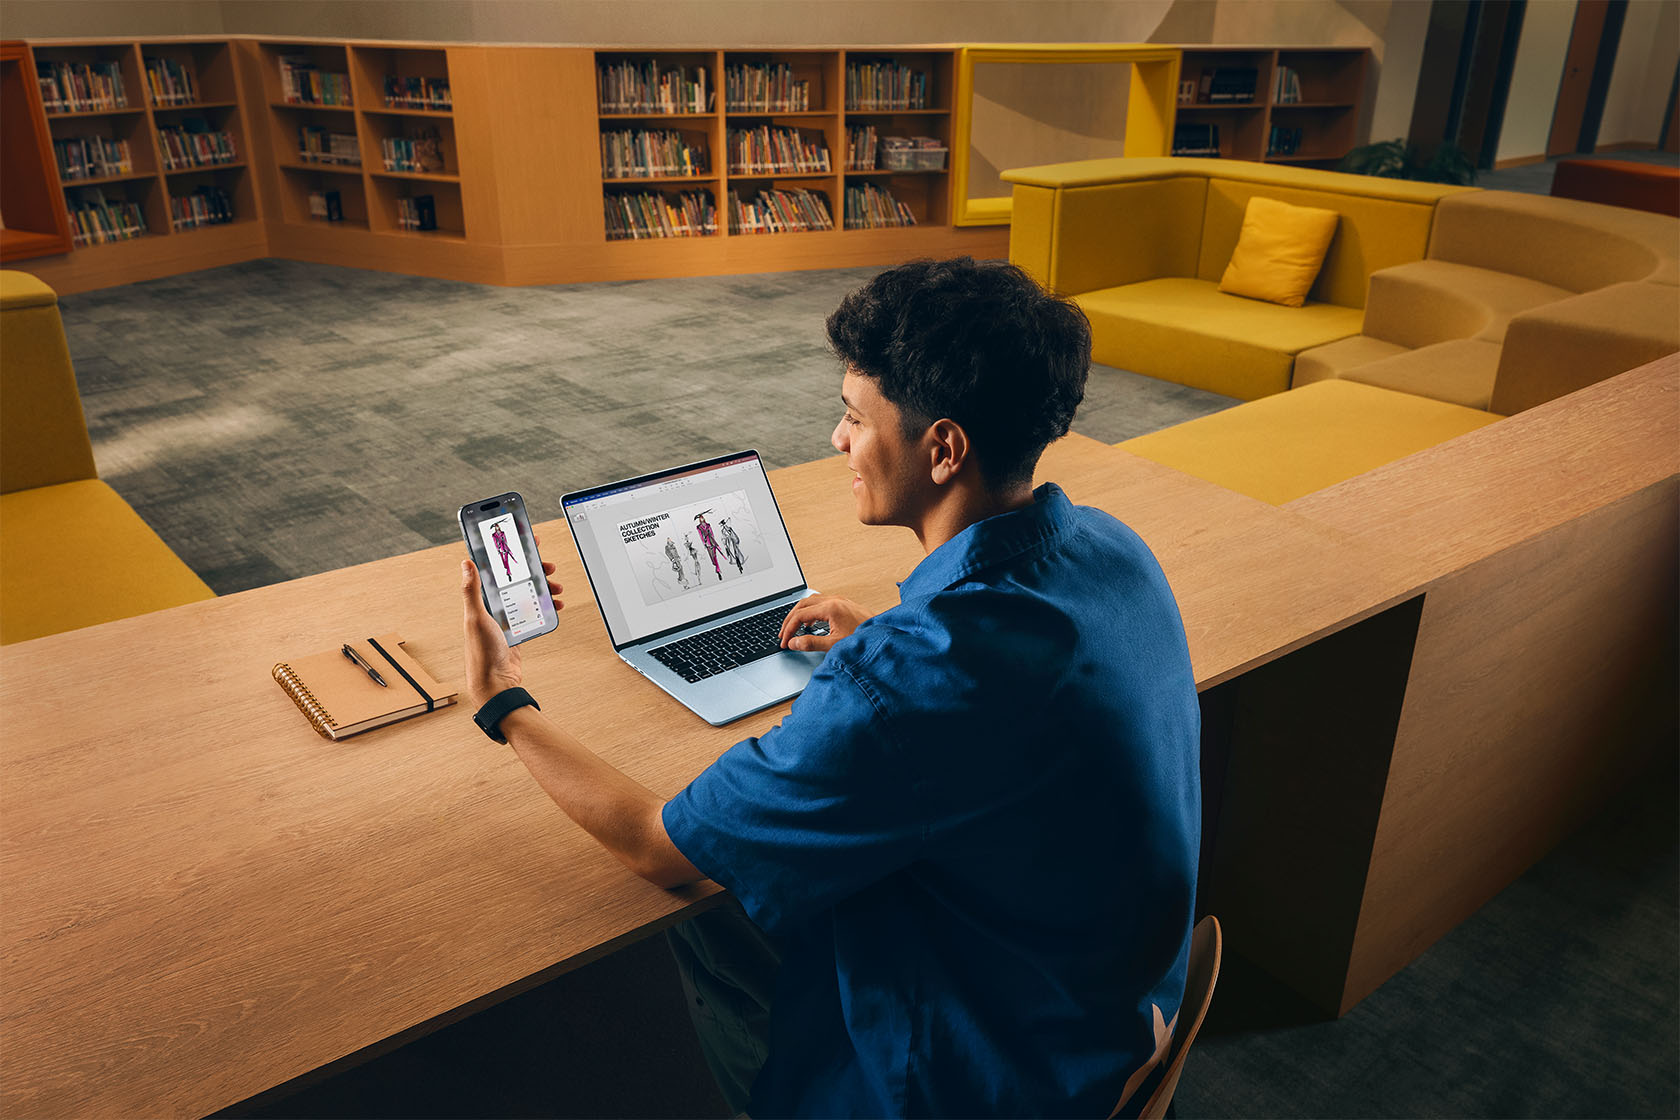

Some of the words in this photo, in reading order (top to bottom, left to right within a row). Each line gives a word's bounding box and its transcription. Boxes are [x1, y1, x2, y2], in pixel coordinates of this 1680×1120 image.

[620, 513, 670, 531] AUTUMN/WINTER
[622, 523, 659, 537] COLLECTION
[623, 530, 656, 544] SKETCHES
